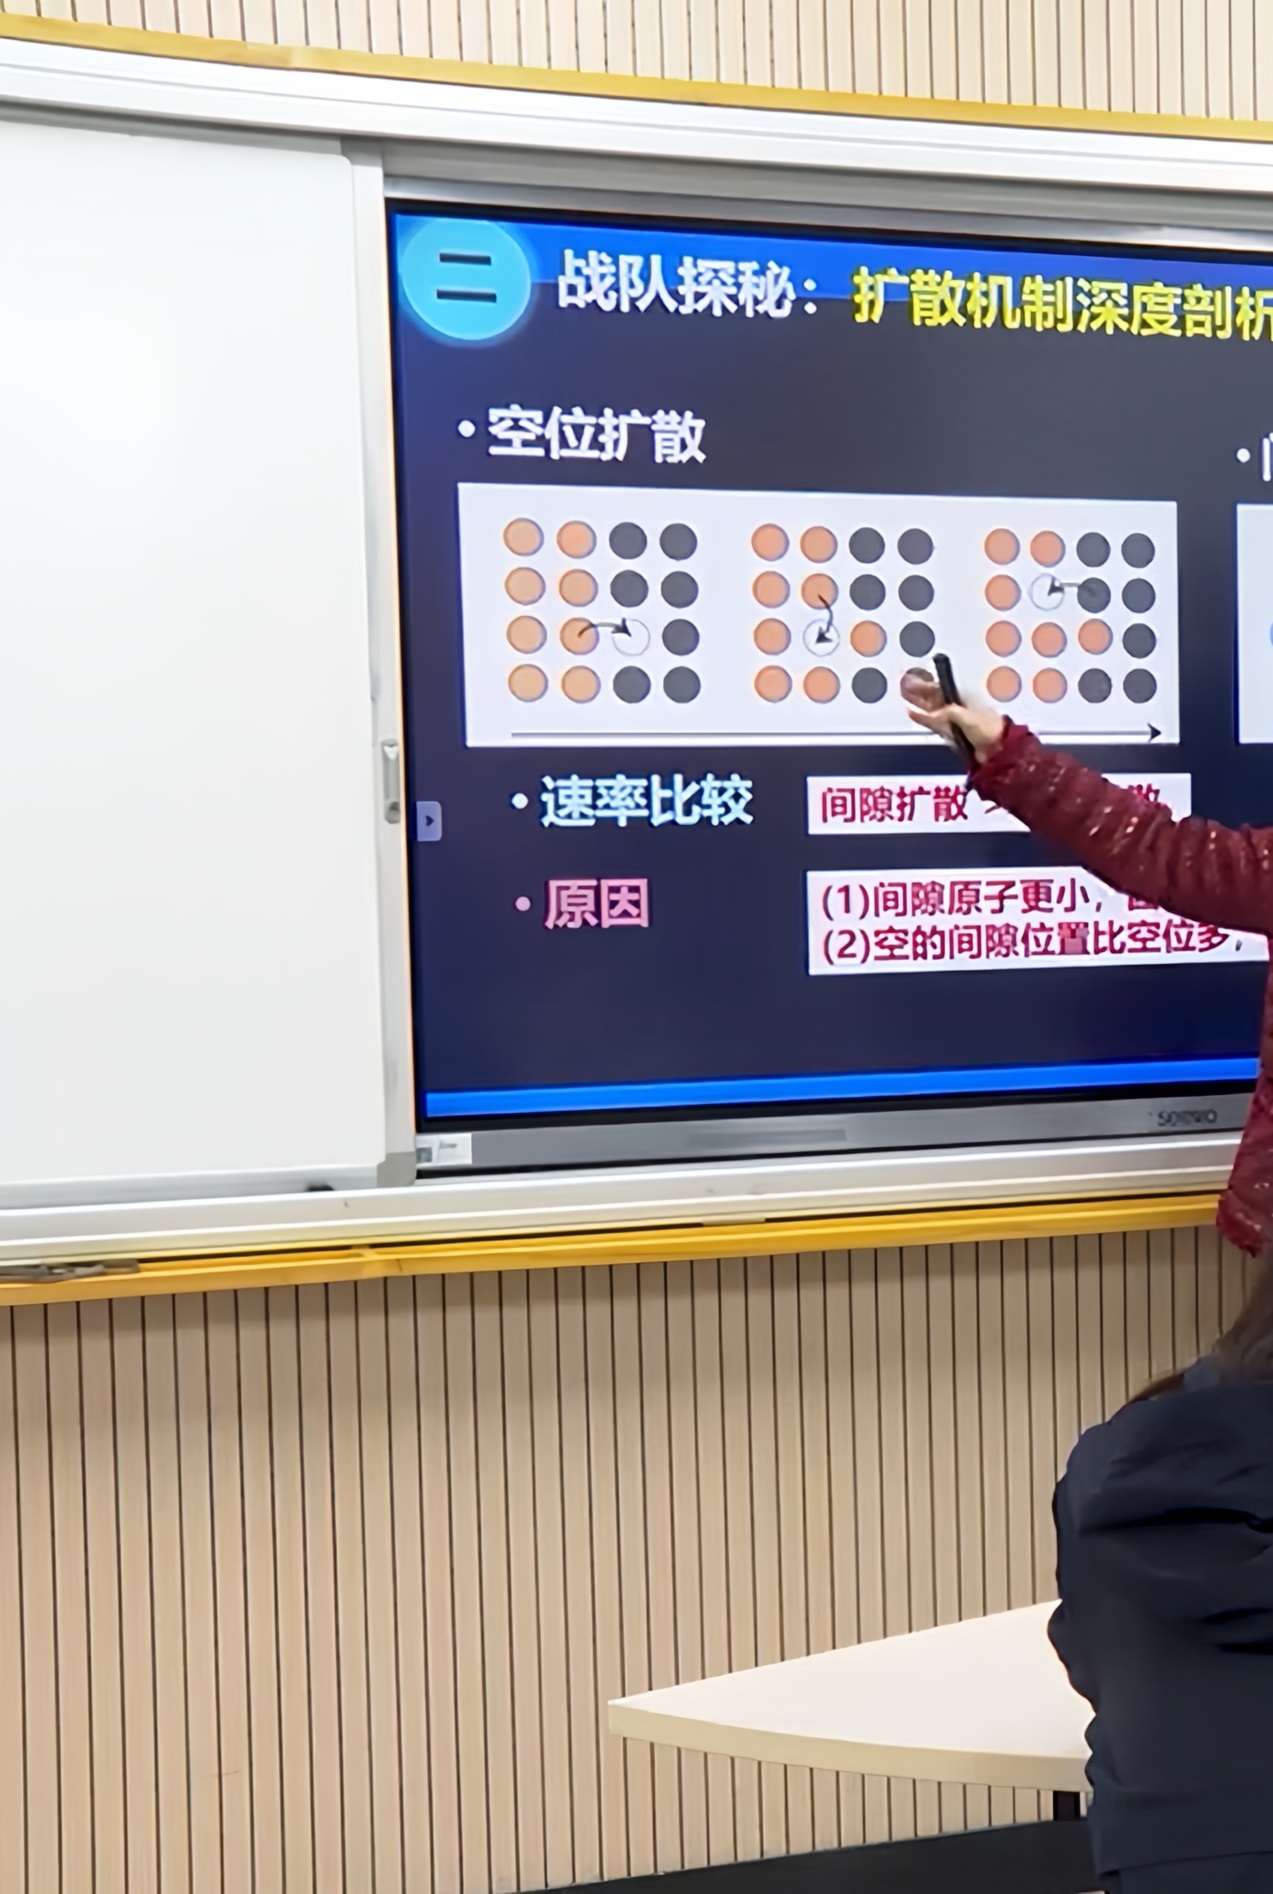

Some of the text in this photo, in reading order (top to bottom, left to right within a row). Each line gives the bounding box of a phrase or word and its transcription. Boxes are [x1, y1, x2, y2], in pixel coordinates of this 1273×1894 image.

[436, 252, 497, 303] 二
[487, 403, 707, 463] 空位扩散
[540, 773, 753, 828] 速率比较
[821, 785, 969, 823] 间隙扩散
[543, 877, 651, 930] 原因
